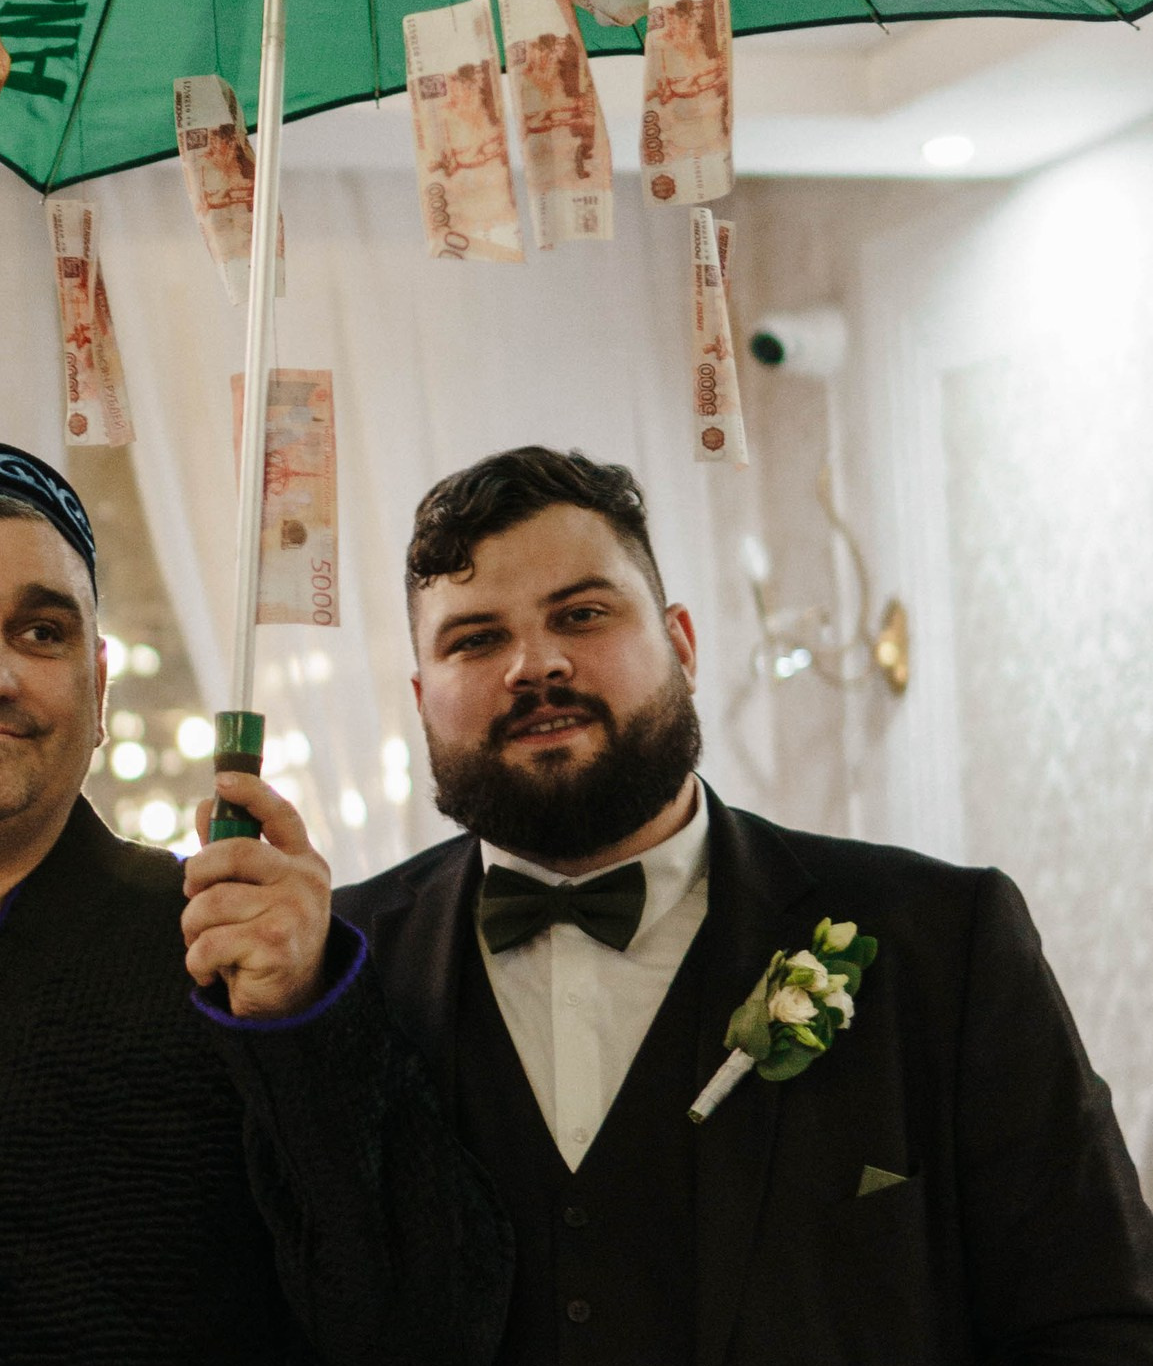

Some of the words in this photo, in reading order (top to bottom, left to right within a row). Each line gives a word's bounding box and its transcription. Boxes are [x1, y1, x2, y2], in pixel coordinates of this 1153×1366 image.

[426, 182, 451, 232] 000
[697, 363, 718, 416] 5000
[311, 557, 333, 626] 5000
